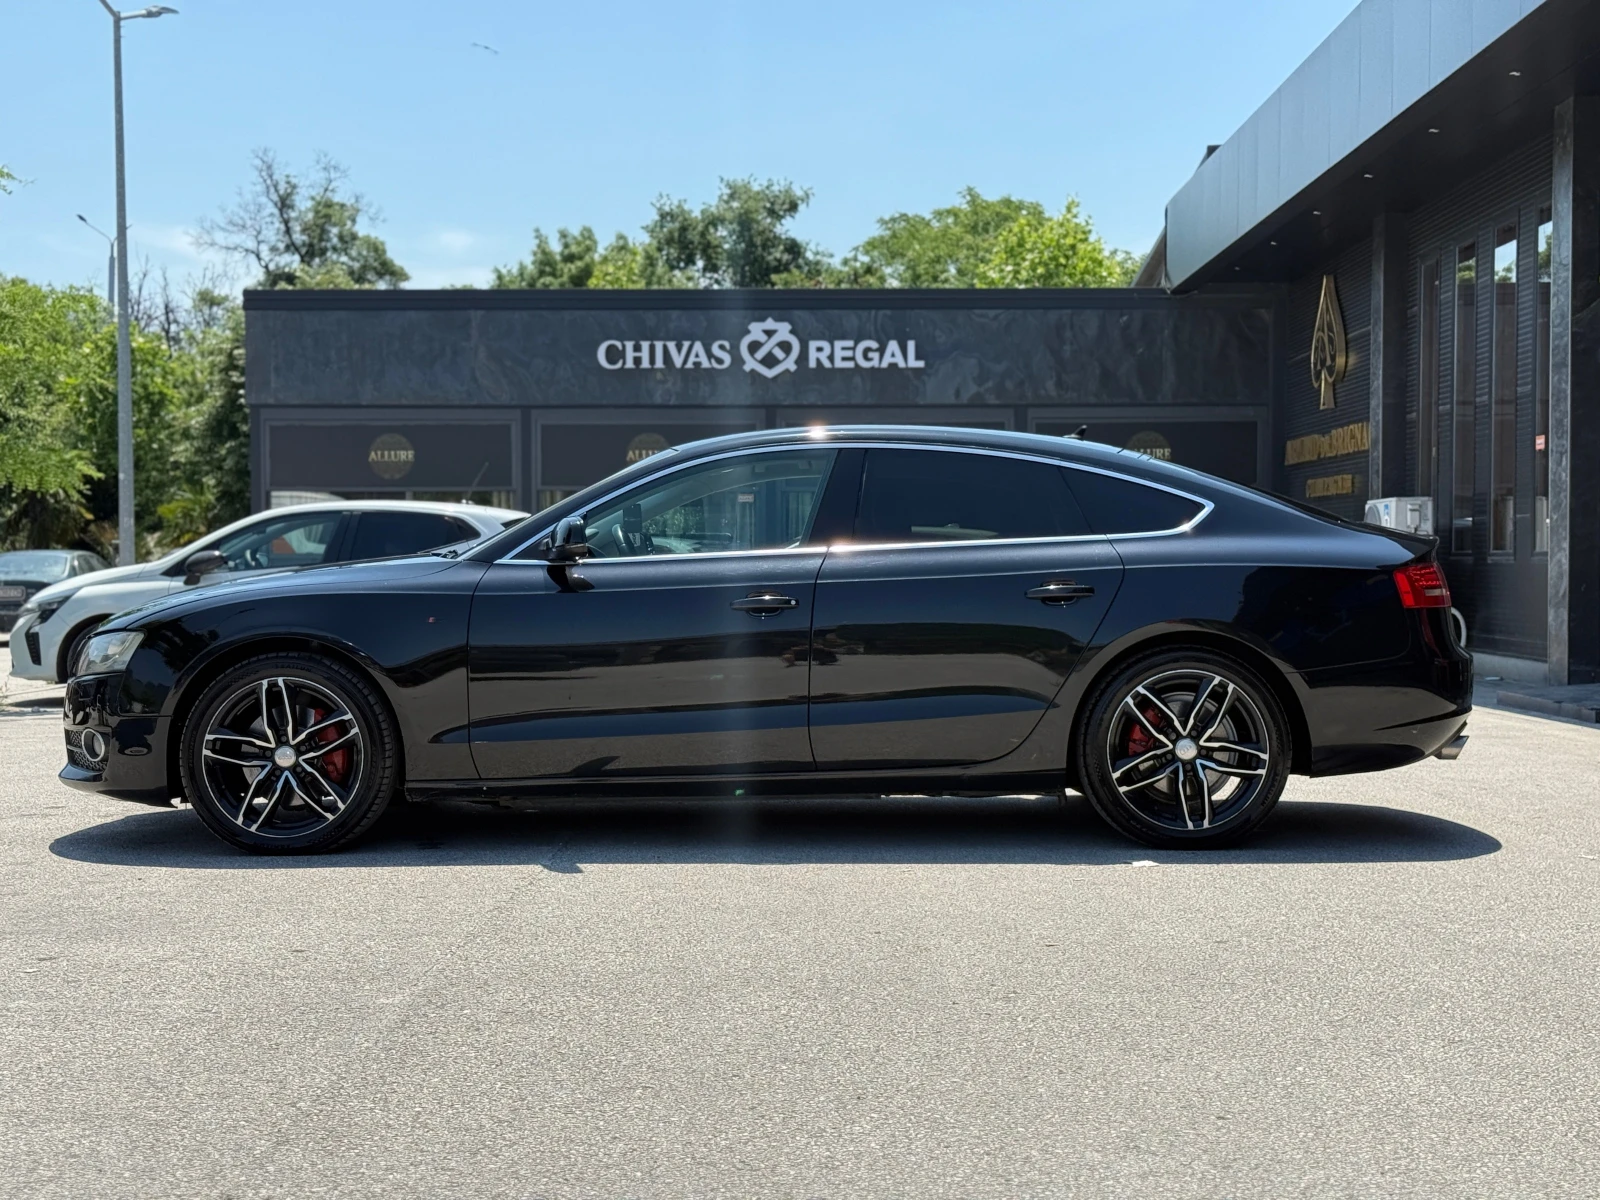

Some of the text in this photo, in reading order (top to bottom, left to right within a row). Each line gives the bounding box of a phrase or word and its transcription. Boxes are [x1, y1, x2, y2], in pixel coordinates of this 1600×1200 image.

[597, 340, 925, 369] CHIVAS REGAL
[1331, 421, 1370, 456] BRIGNA
[368, 450, 415, 462] ALLURE
